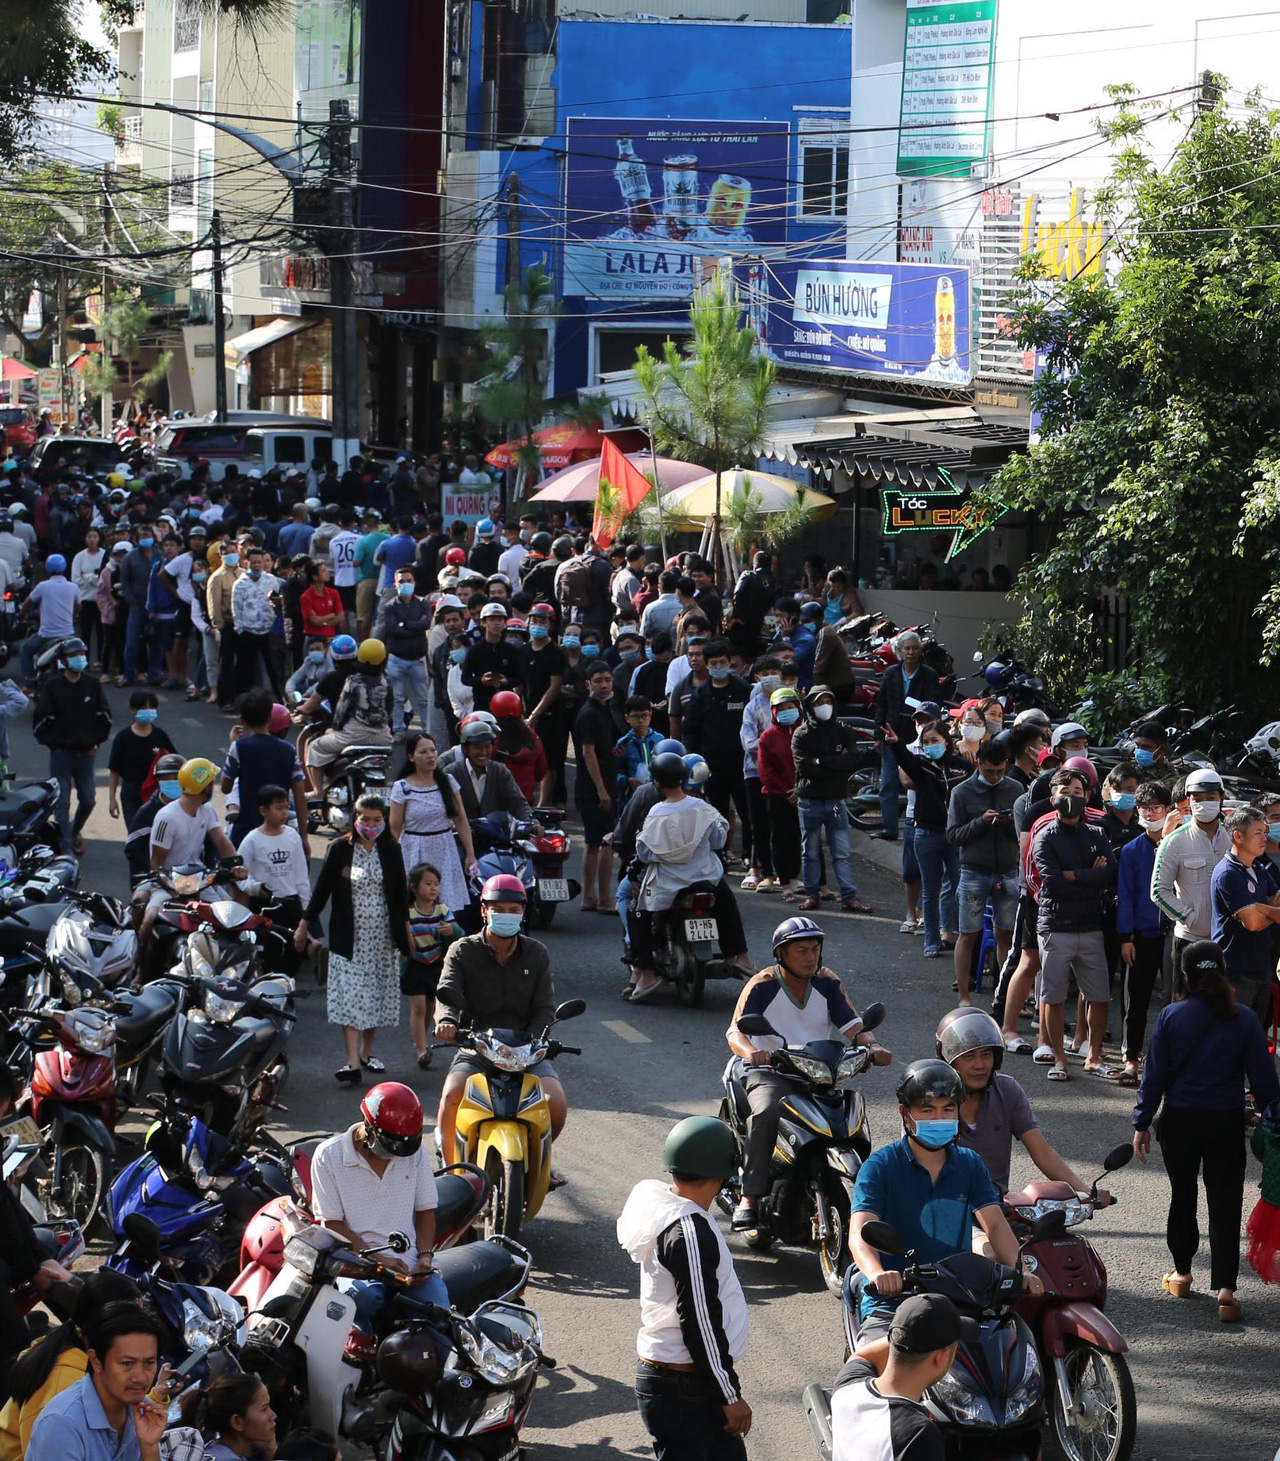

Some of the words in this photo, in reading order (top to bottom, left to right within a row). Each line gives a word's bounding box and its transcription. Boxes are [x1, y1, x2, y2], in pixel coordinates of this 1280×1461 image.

[605, 253, 670, 274] LALA
[805, 276, 830, 315] BÚN
[335, 542, 354, 564] 26
